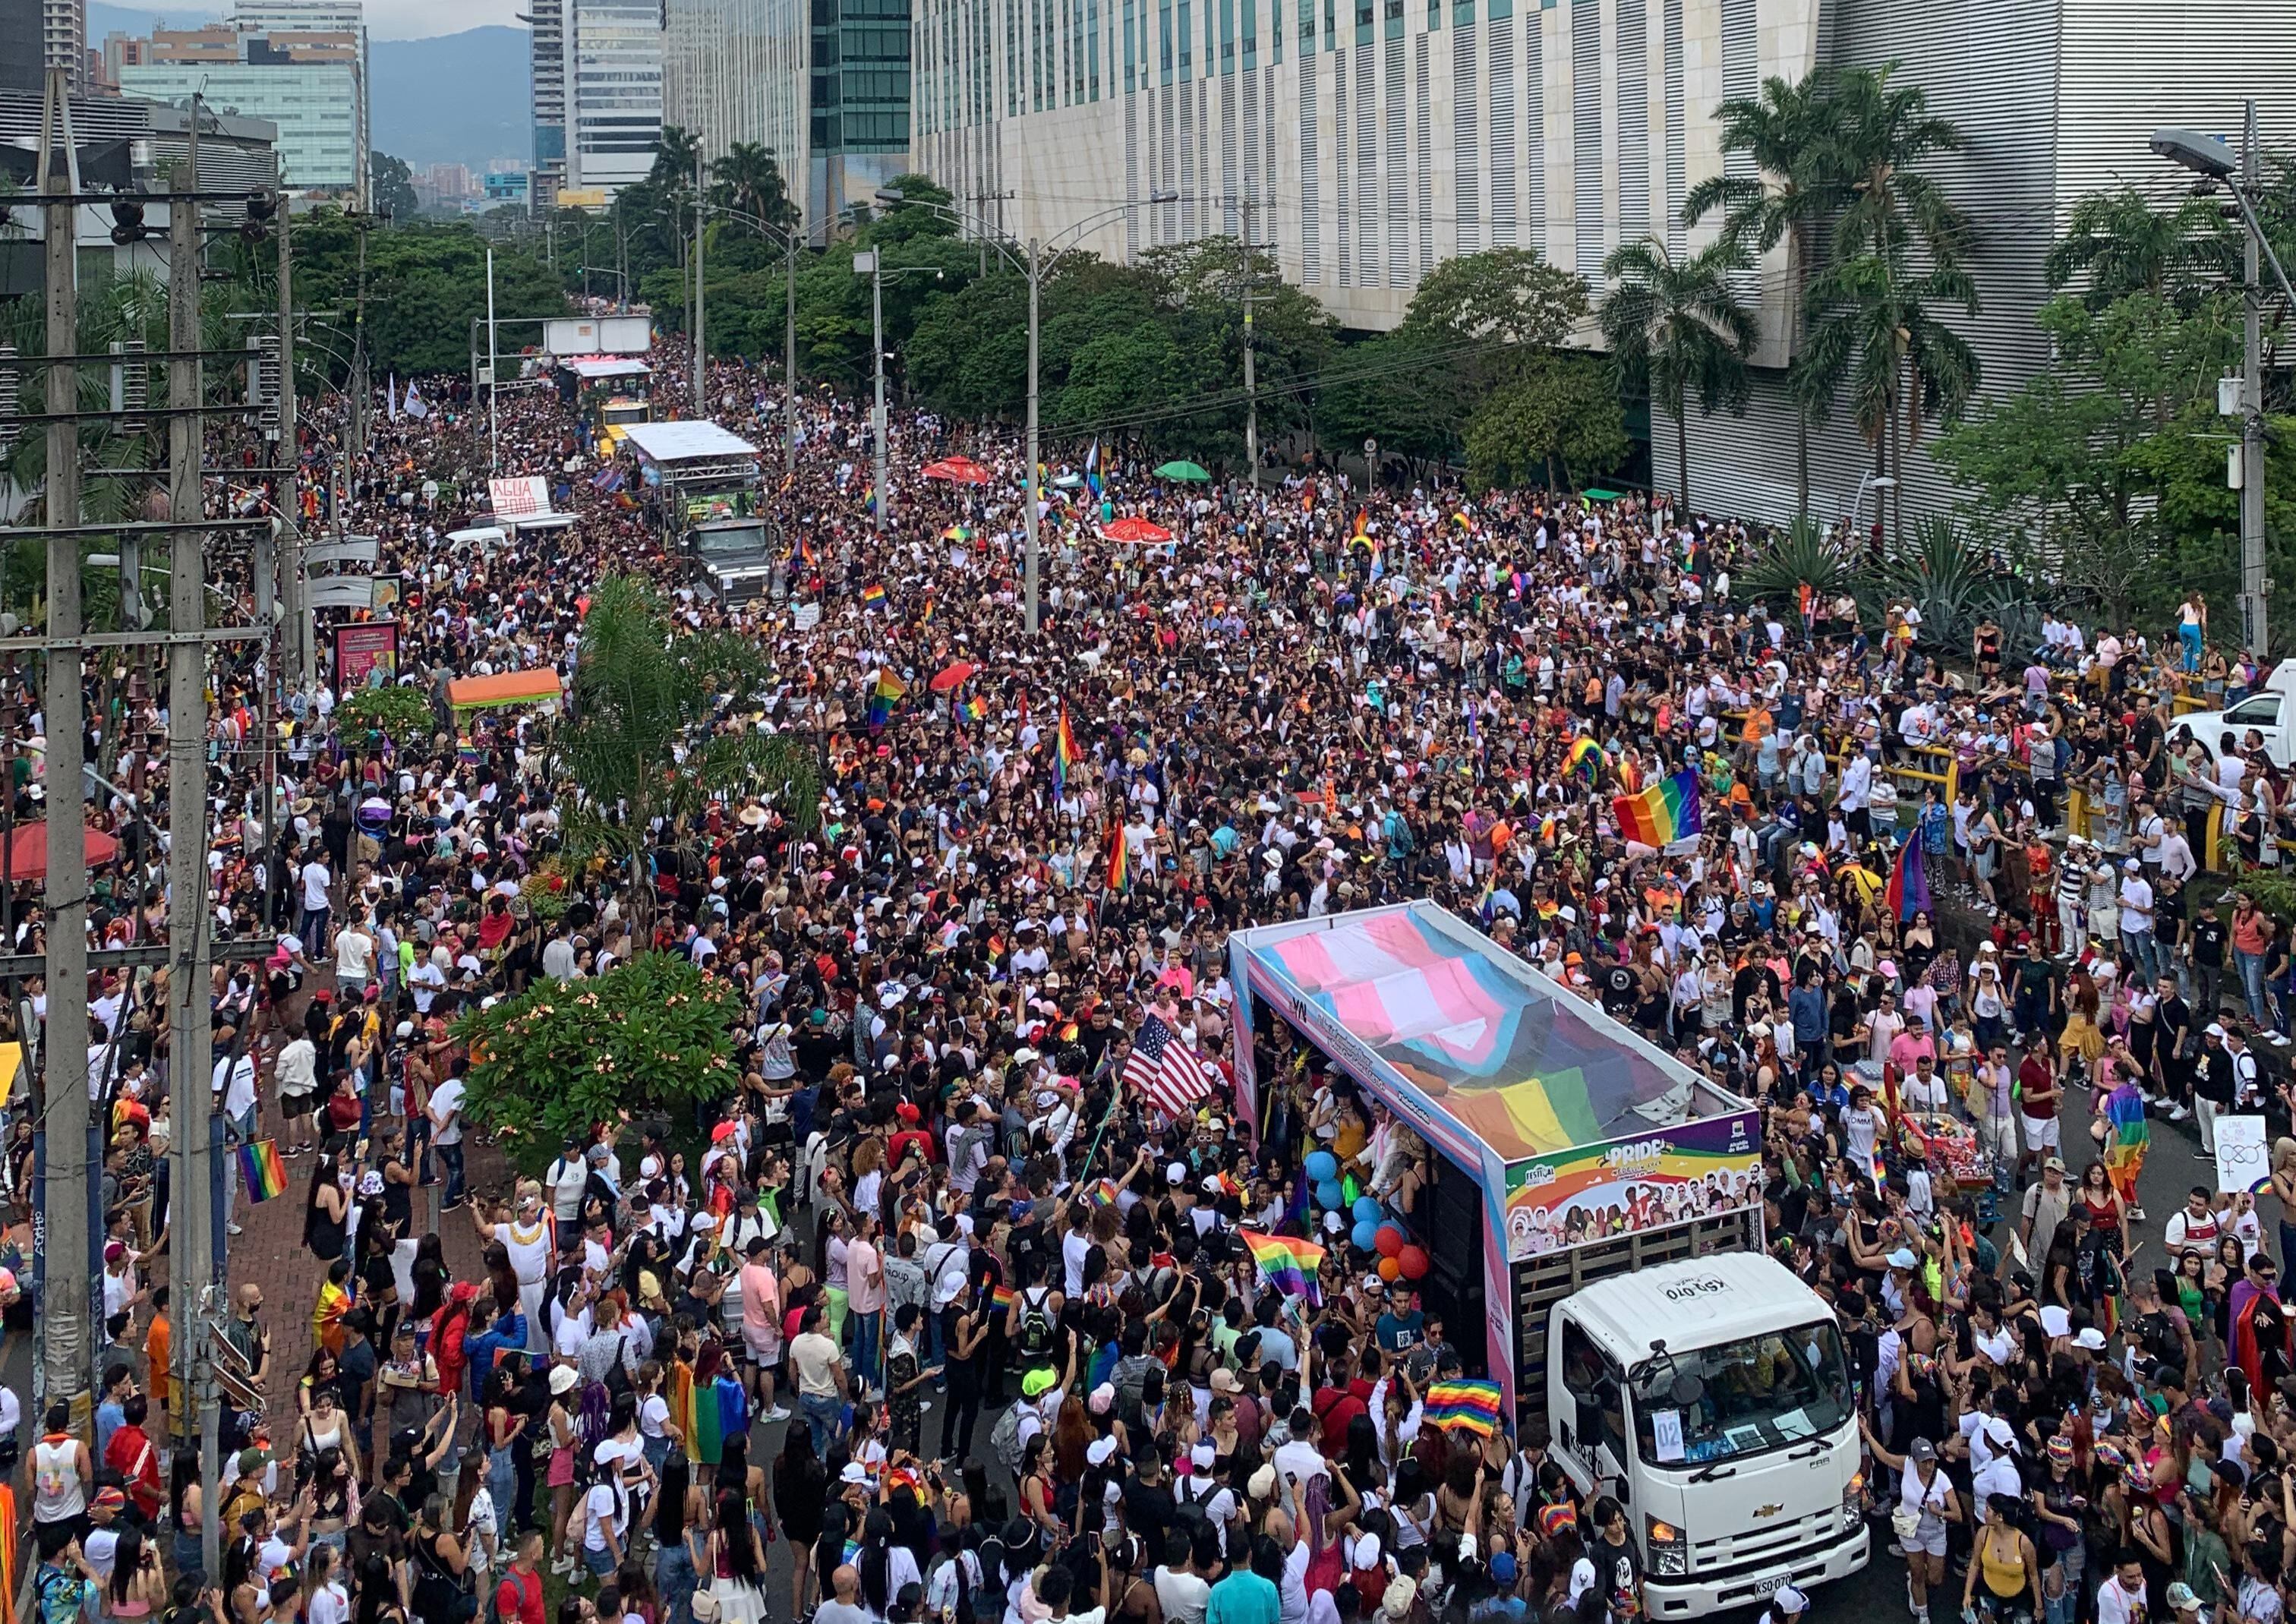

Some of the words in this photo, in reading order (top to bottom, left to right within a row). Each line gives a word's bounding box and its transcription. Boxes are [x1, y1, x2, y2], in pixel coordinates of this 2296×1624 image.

[494, 481, 531, 497] AGUA
[495, 497, 536, 515] 2000
[1610, 1139, 1661, 1167] PRIDE
[1657, 1422, 1679, 1448] 02
